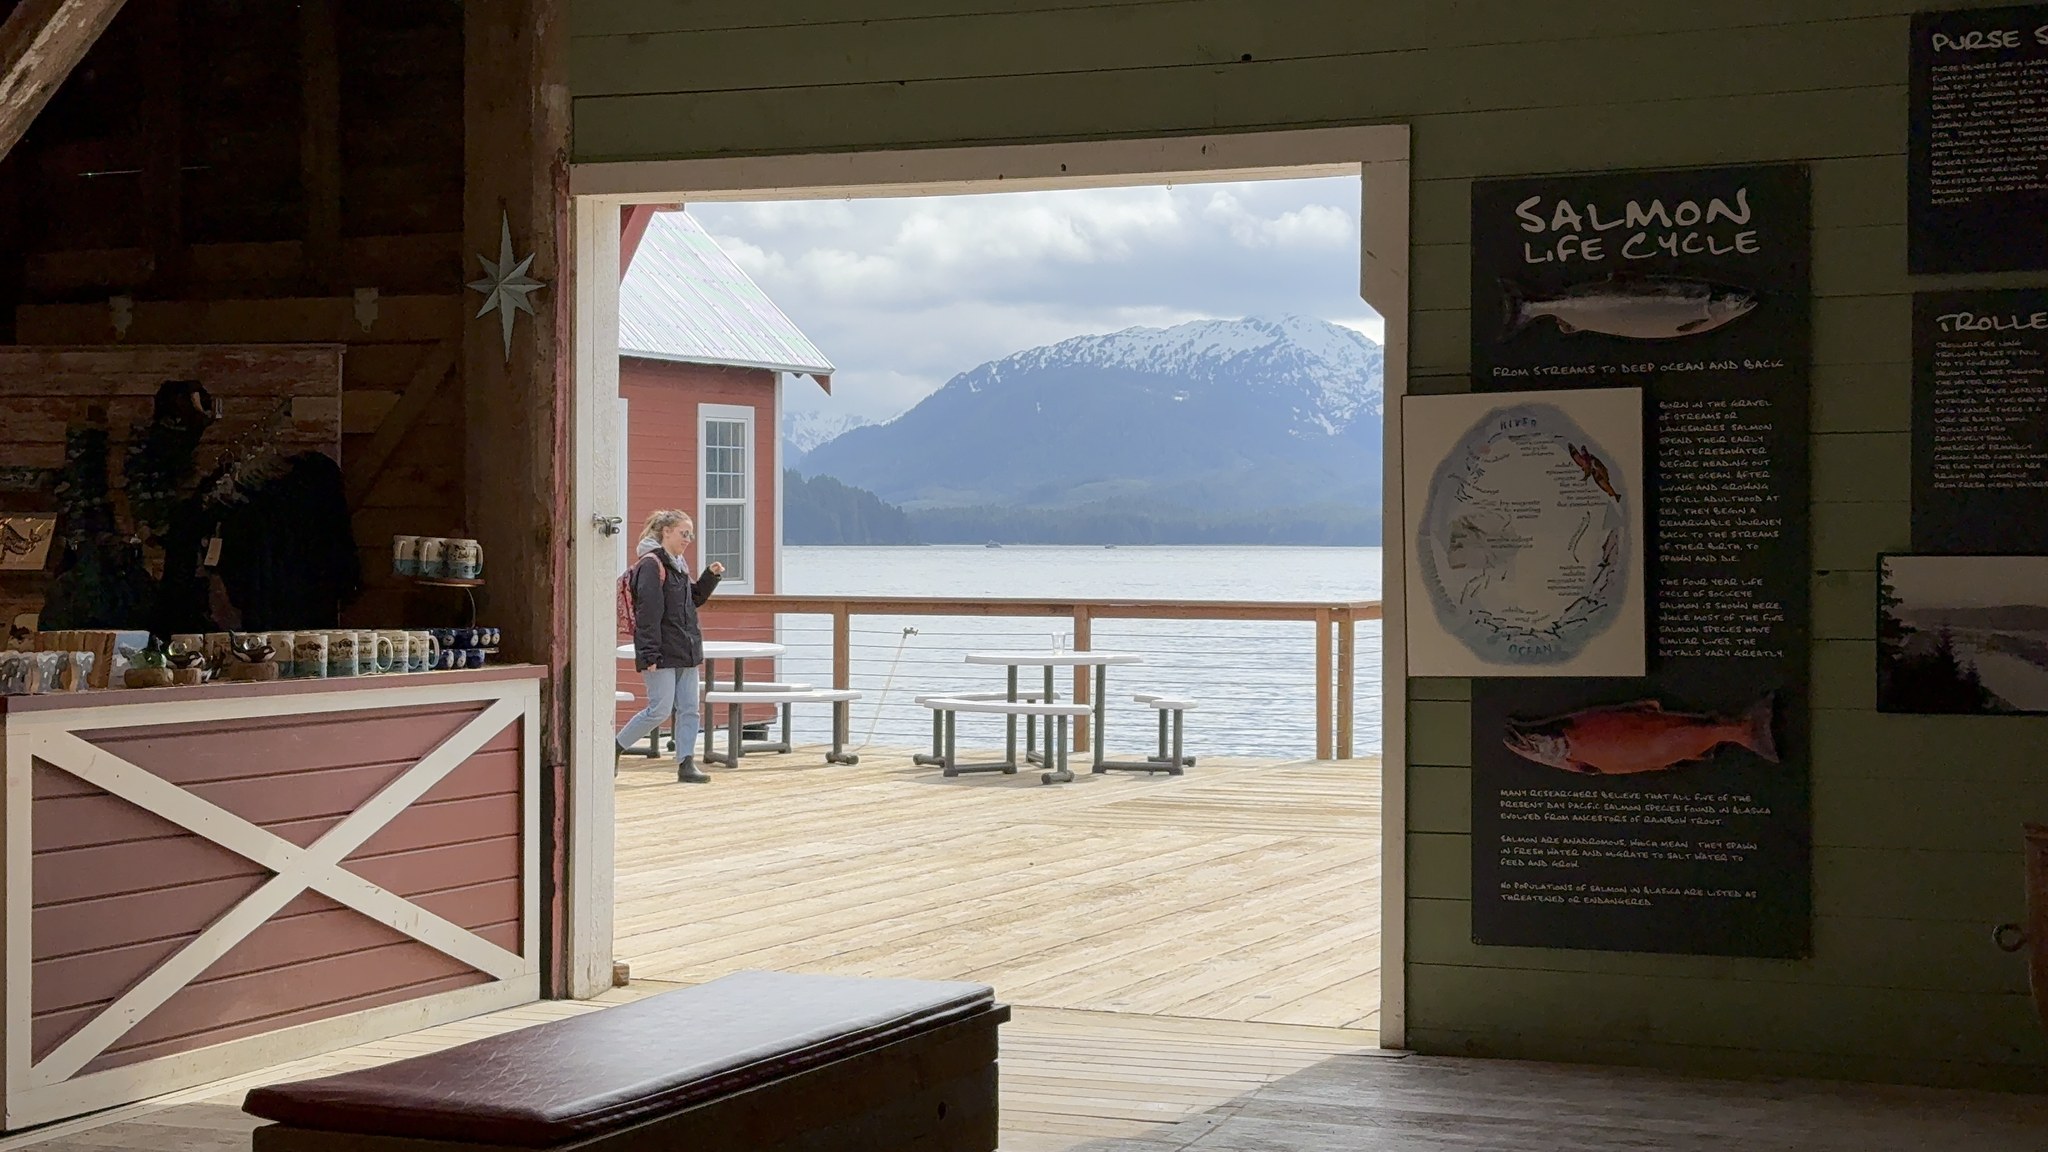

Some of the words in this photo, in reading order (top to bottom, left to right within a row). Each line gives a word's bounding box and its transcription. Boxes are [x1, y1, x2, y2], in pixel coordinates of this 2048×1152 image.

[1932, 30, 2020, 52] PURSE
[1515, 188, 1750, 232] SALMON
[1524, 236, 1604, 264] LIFE
[1622, 231, 1760, 260] CYCLE
[1936, 312, 2048, 332] TROLLE
[1493, 367, 1529, 377] FROM
[1534, 364, 1595, 376] STREAMS
[1600, 366, 1616, 374] TO
[1621, 363, 1654, 373] DEEP
[1660, 361, 1704, 372] OCEAN
[1710, 360, 1738, 370] AND
[1744, 358, 1784, 368] BACK
[1530, 790, 1597, 798] RESEARCHERS
[1601, 790, 1640, 799] BELIEVE
[1684, 805, 1715, 813] FOUND
[1733, 806, 1771, 814] ALASKA
[1644, 816, 1686, 824] RAINBOW
[1630, 839, 1658, 847] WHICH
[1695, 853, 1728, 861] WATER
[1515, 882, 1572, 891] POPULATIONS
[1644, 886, 1680, 894] ALASKA
[1500, 894, 1564, 902] THREATENED
